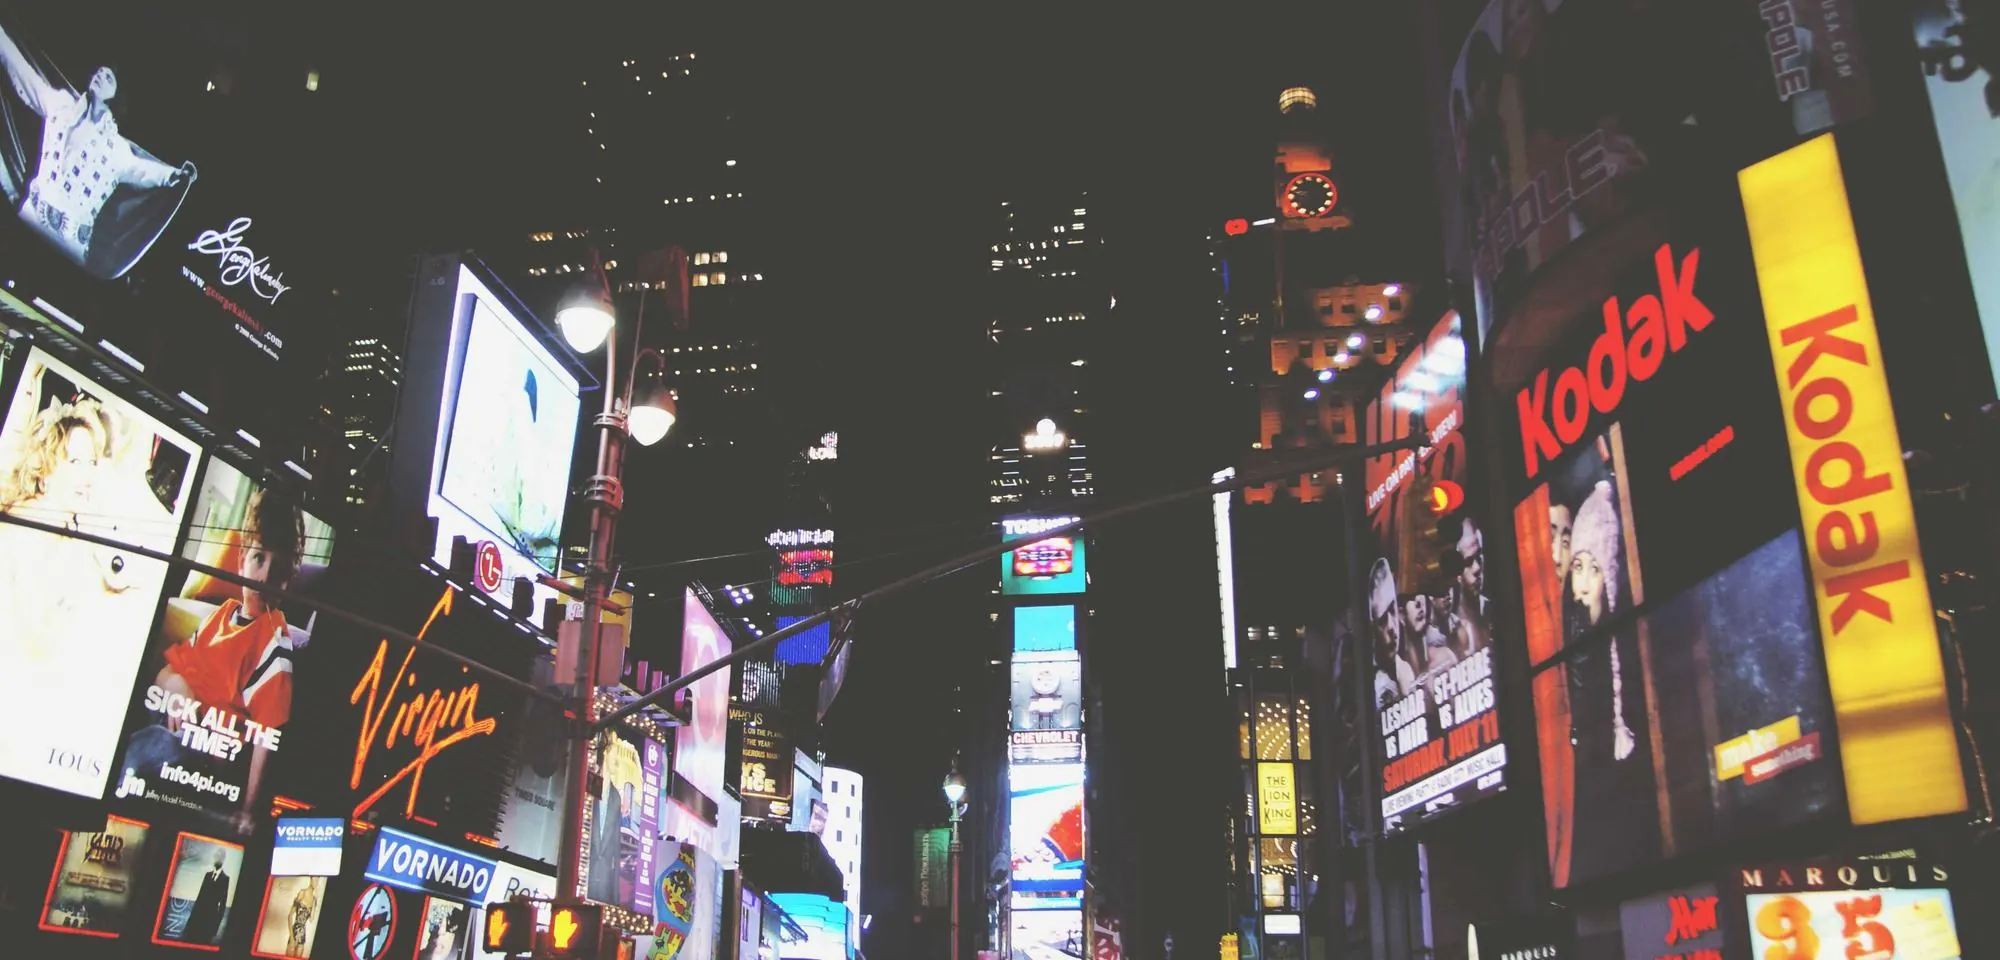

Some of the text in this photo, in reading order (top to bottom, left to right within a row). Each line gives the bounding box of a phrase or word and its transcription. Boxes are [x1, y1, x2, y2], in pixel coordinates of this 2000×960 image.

[1516, 242, 1715, 479] Kodak
[1780, 303, 1911, 637] Kodak
[1434, 646, 1492, 706] ST-PIERRE
[144, 684, 282, 752] SICK ALL THE
[350, 585, 496, 820] Virgin
[1381, 688, 1426, 737] LESNAR
[1454, 678, 1495, 725] ALVES
[181, 722, 243, 762] TIME?
[1013, 731, 1079, 744] CHEVROLET
[1398, 716, 1428, 756] MIR
[1448, 718, 1480, 761] JULY
[1482, 709, 1499, 744] 11
[48, 747, 101, 777] TOUS
[160, 761, 241, 802] info4pi.org
[1266, 776, 1287, 786] THE
[1263, 788, 1290, 805] LION
[1263, 808, 1292, 825] KING
[277, 825, 344, 837] VORNADO
[377, 837, 490, 895] VORNADO
[1741, 864, 1949, 888] MARQUIS
